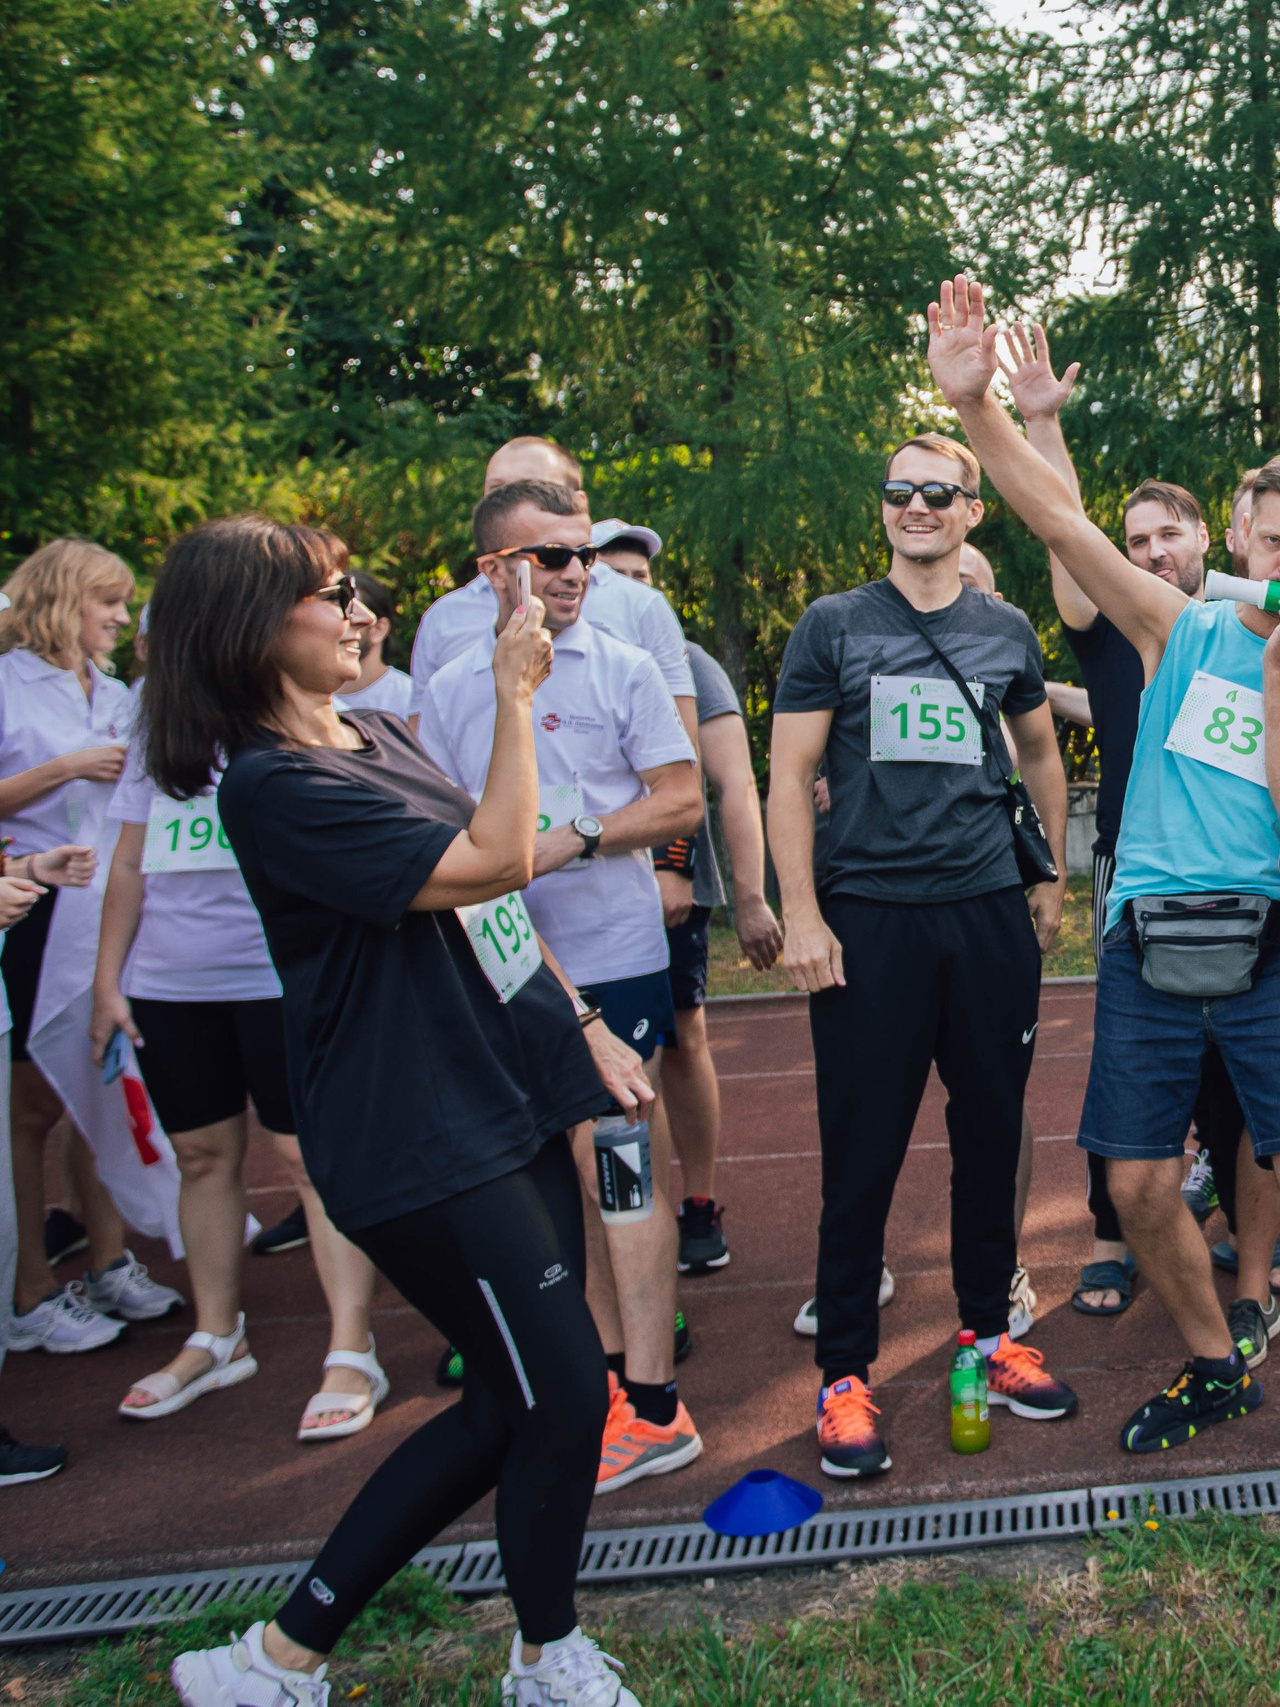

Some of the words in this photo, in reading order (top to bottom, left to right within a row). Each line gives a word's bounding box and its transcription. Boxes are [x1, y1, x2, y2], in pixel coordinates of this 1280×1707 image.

[890, 702, 966, 742] 155
[1203, 706, 1264, 755] 83
[482, 895, 530, 964] 193
